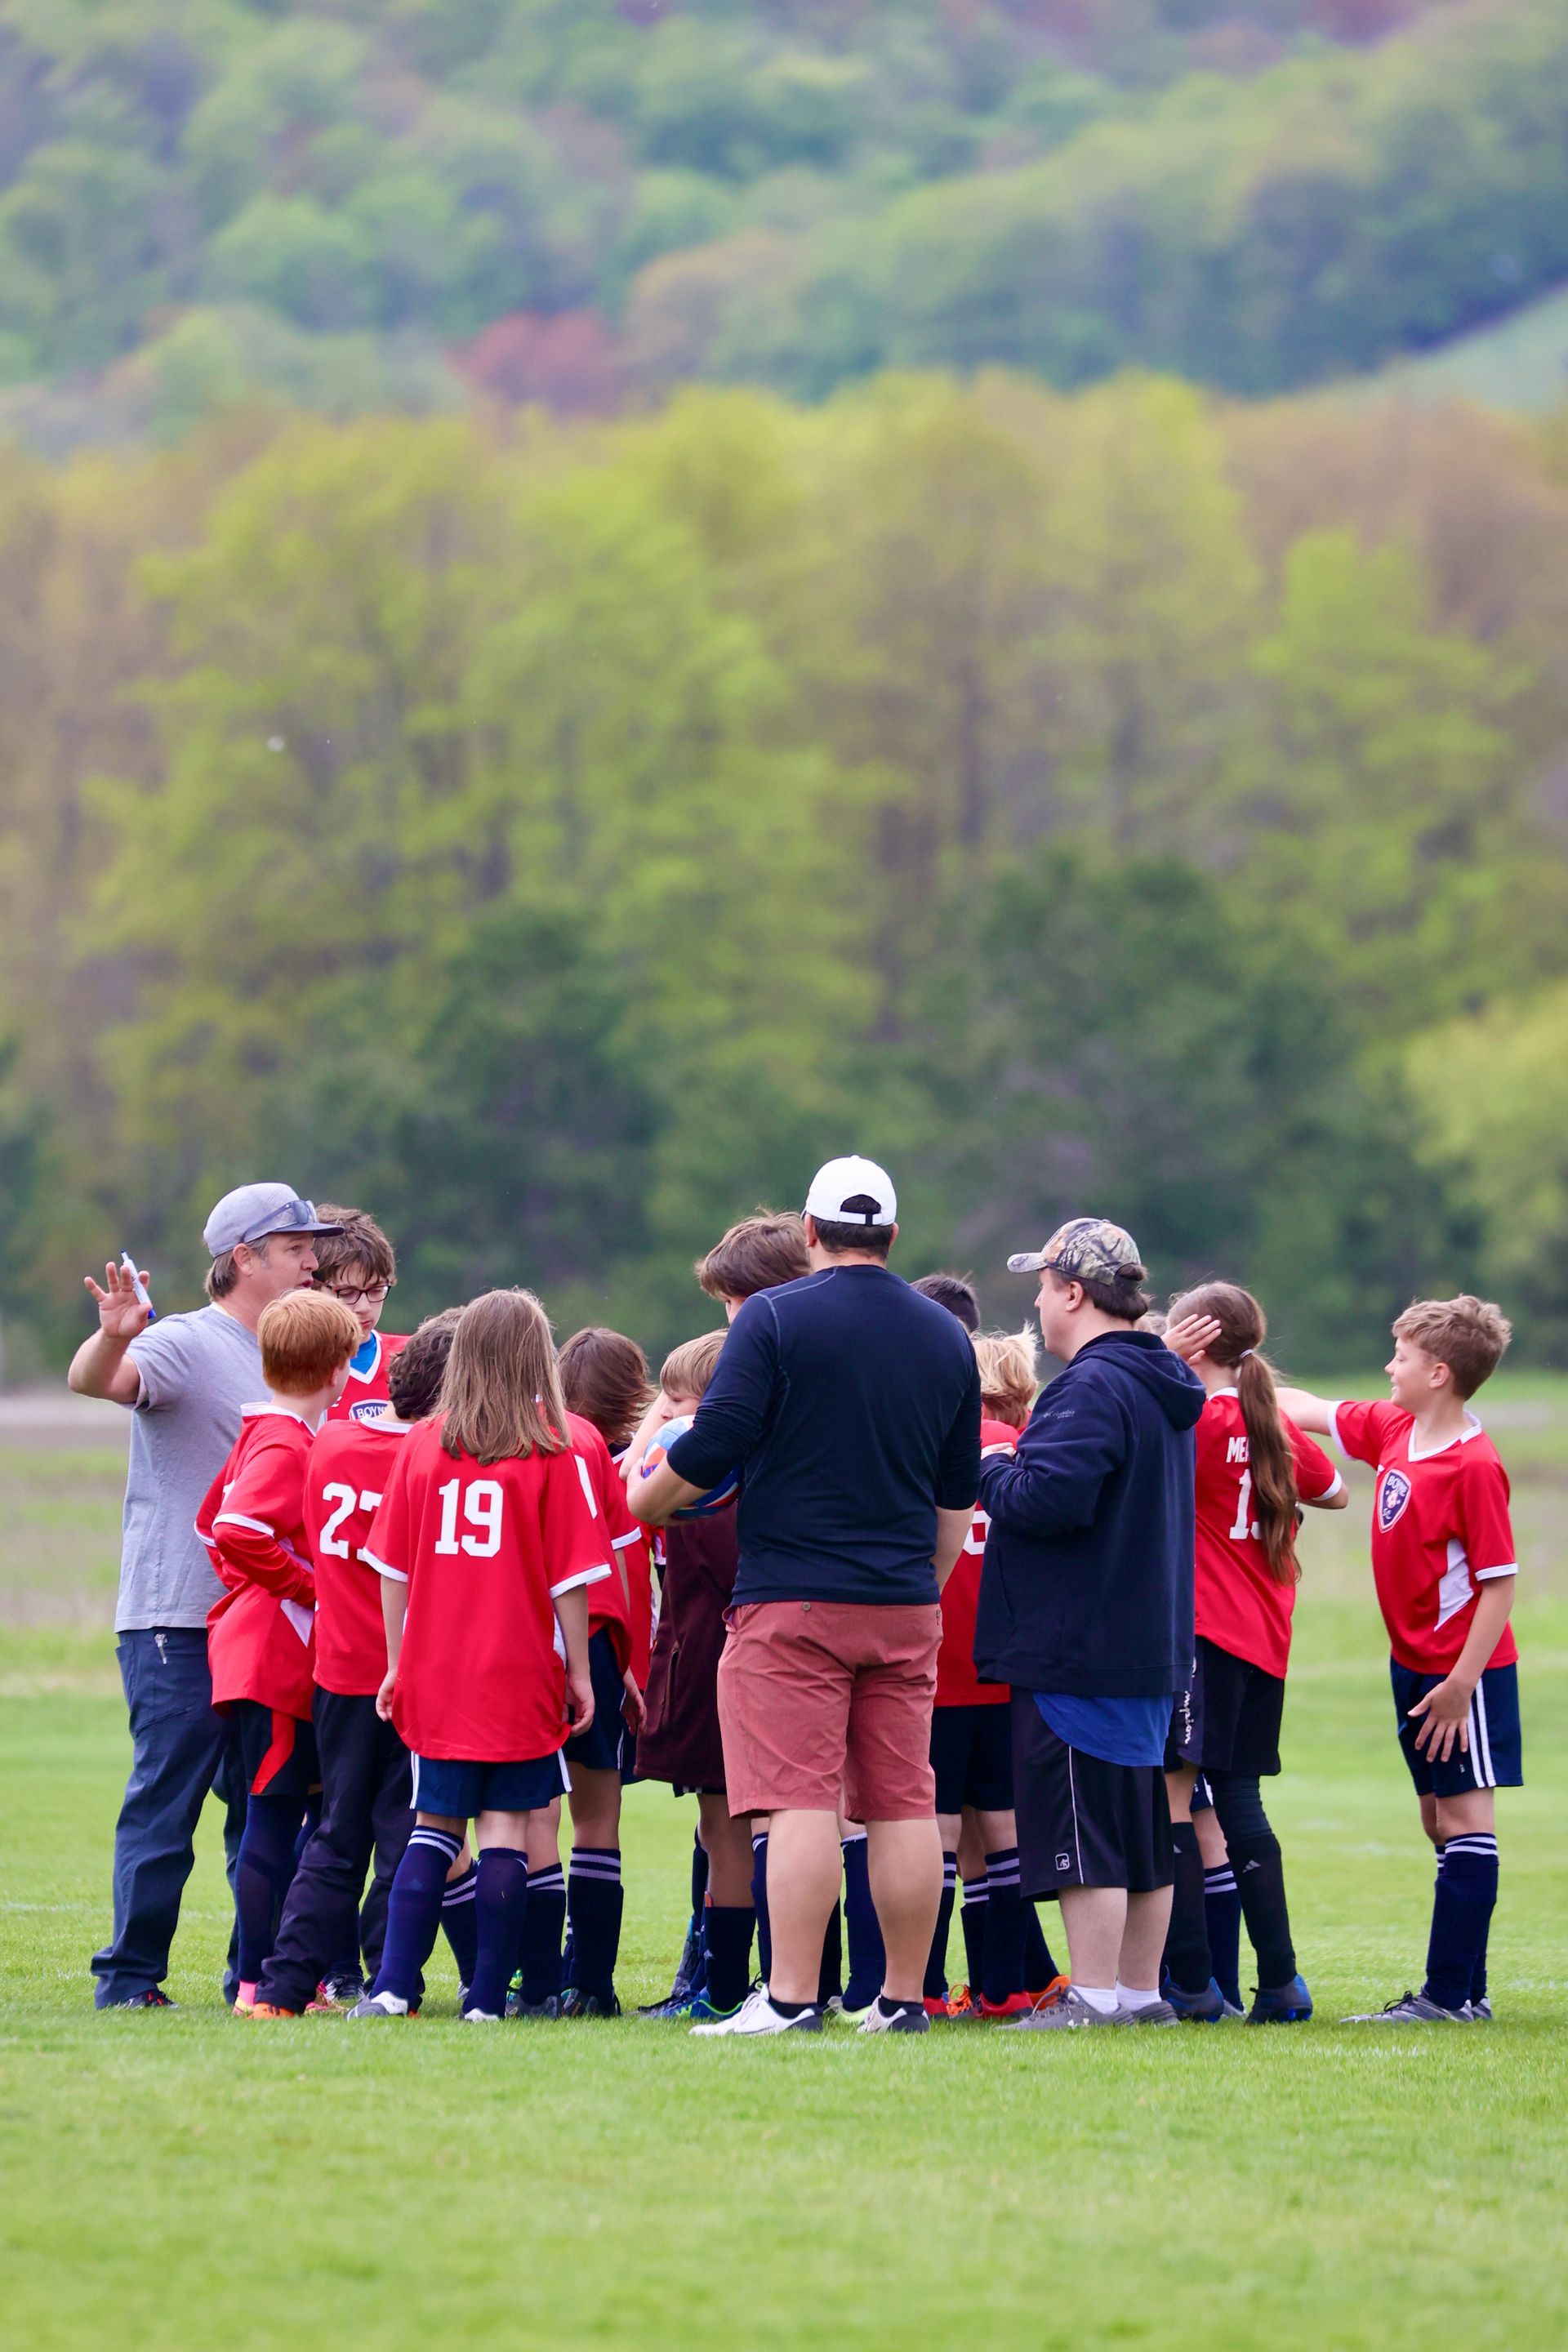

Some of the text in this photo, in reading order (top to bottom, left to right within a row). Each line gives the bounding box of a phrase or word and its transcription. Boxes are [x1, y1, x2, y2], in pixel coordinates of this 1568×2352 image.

[356, 1405, 386, 1419] BOYN
[1229, 1468, 1262, 1539] 1
[1387, 1475, 1408, 1497] BOYNE
[434, 1478, 504, 1557] 19
